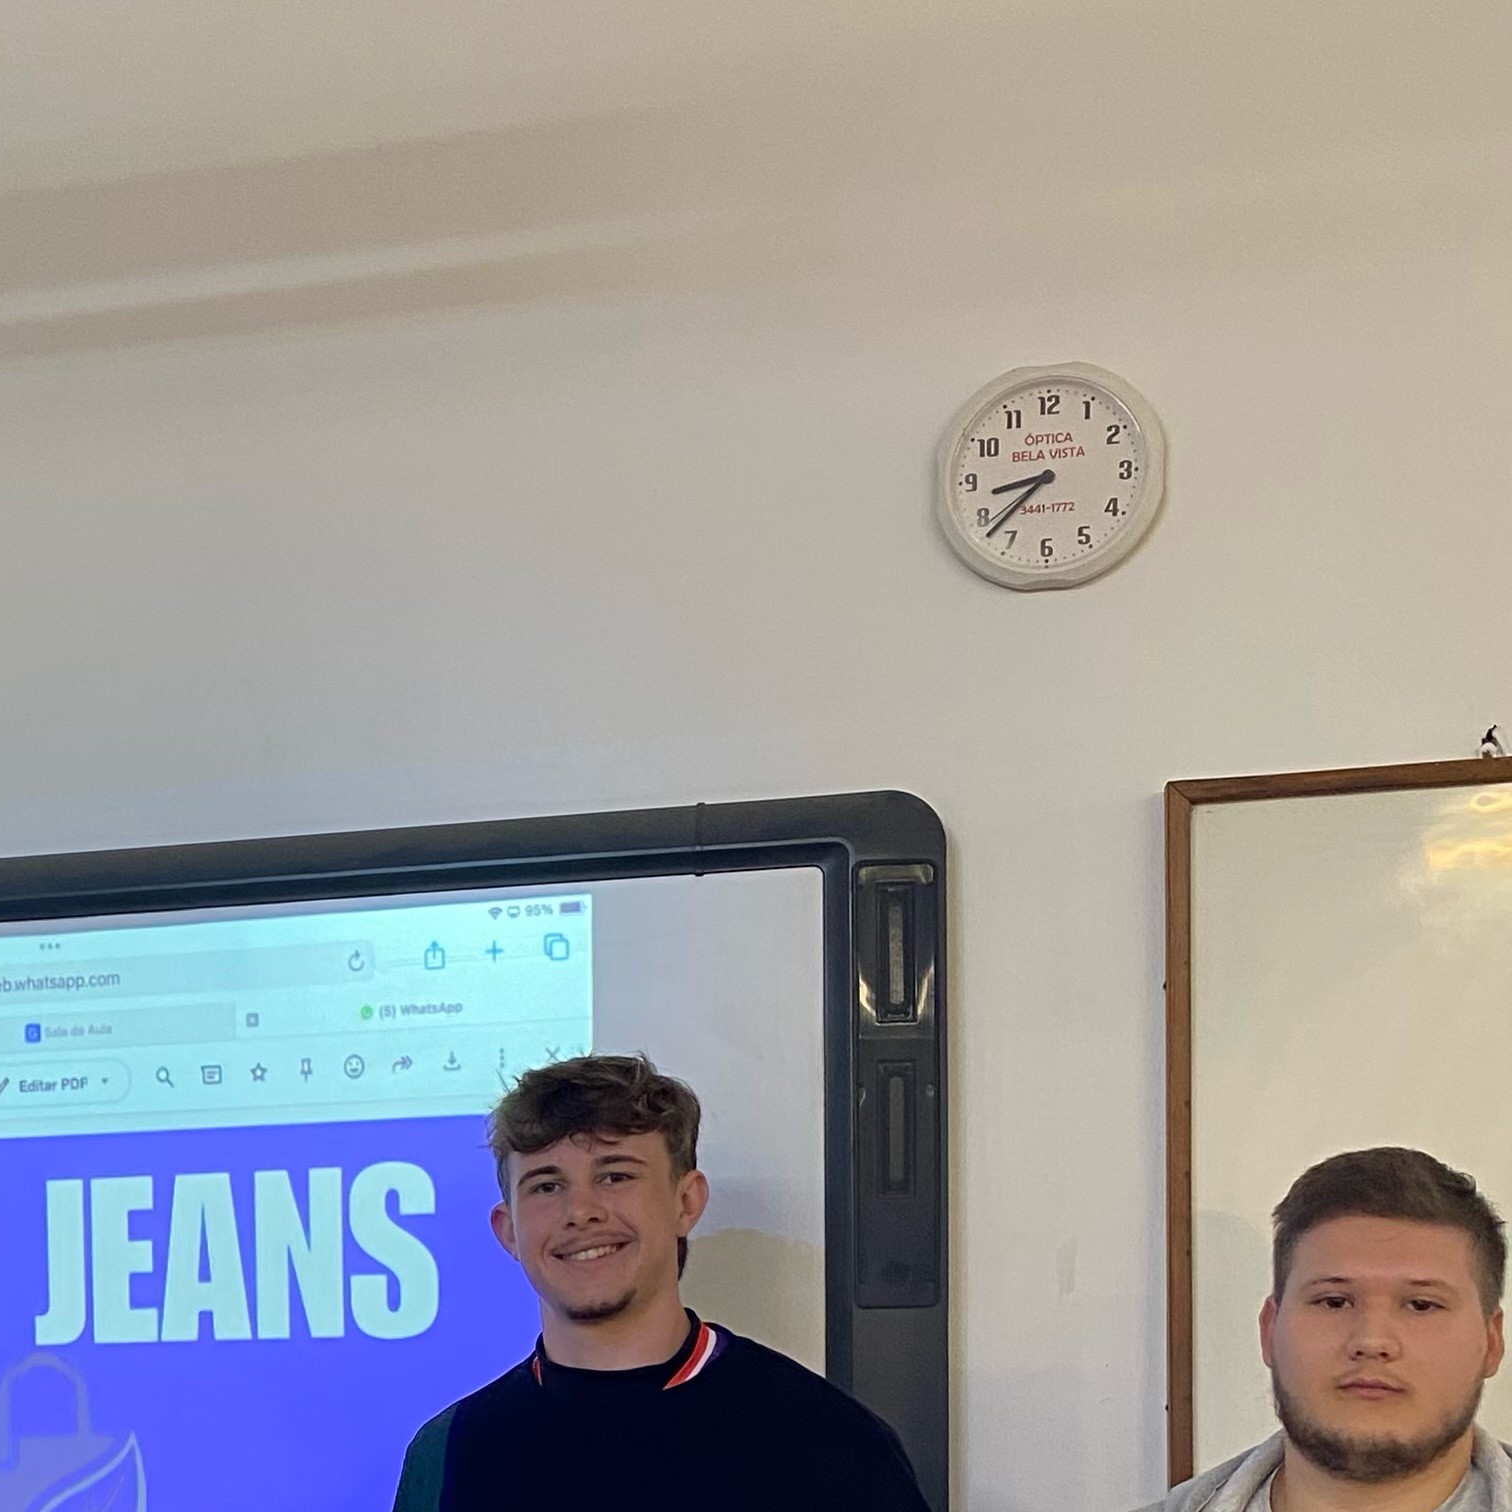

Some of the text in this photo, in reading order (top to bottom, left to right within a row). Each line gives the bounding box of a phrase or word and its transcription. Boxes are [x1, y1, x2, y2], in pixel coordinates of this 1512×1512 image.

[1038, 395, 1060, 415] 12
[1082, 400, 1091, 419] 1
[1005, 409, 1022, 429] 11
[1024, 432, 1073, 447] ÓPTICA
[1106, 424, 1120, 444] 2
[978, 437, 999, 458] 10
[1012, 446, 1085, 463] BELA VISTA
[1119, 460, 1133, 480] 3
[965, 473, 978, 492] 9
[1104, 497, 1119, 517] 4
[976, 507, 990, 527] 8
[1004, 530, 1018, 549] 7
[1077, 526, 1091, 545] 5
[1040, 538, 1053, 557] 6
[524, 904, 554, 917] 95%
[379, 1001, 463, 1020] (5) WhatsApp
[44, 1024, 113, 1039] Sala de Aula
[18, 1076, 89, 1093] Editar PDF
[34, 1160, 440, 1346] JEANS
